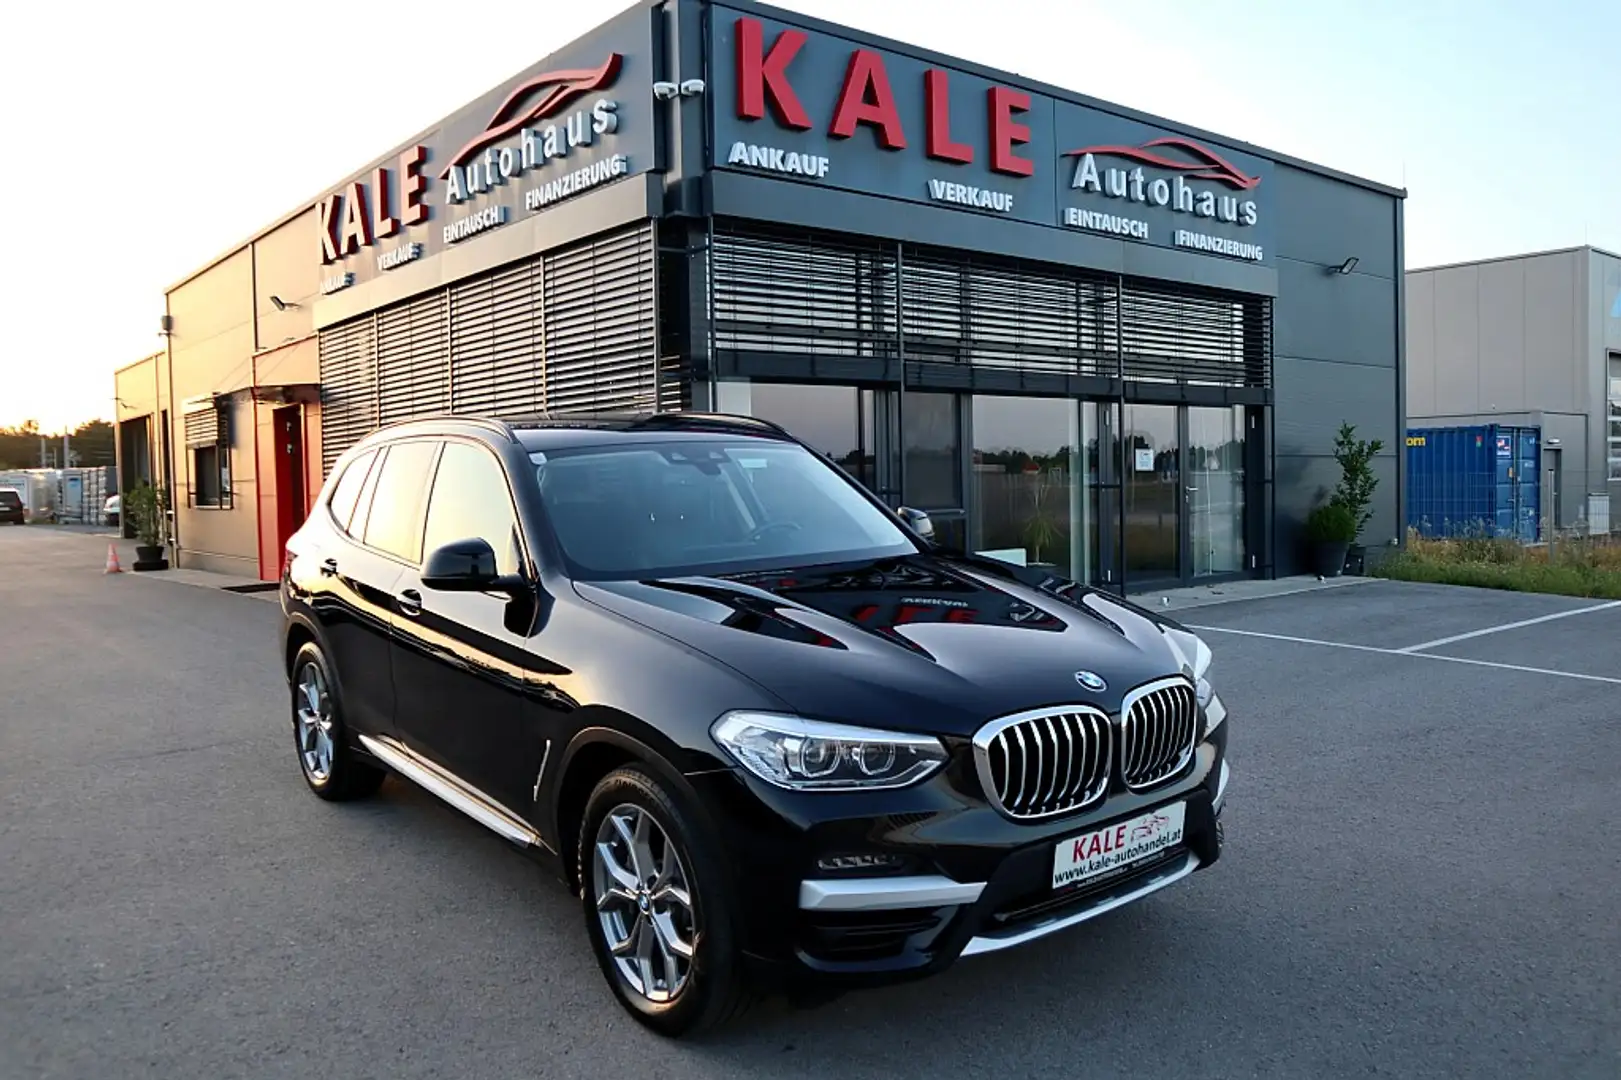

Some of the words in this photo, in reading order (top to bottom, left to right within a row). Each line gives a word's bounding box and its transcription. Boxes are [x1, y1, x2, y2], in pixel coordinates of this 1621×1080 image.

[735, 17, 1034, 177] KALE
[445, 99, 617, 204] Autohaus
[728, 141, 829, 178] ANKAUF
[315, 145, 428, 265] KALE
[525, 154, 627, 210] FINANZIERUNG
[928, 179, 1013, 212] VERKAUF
[1072, 152, 1257, 225] Autohaus
[443, 205, 506, 243] EINTAUSCH
[1064, 208, 1148, 239] EINTAUSCH
[1174, 229, 1263, 260] FINANZIERUNG
[1054, 829, 1181, 883] www.kale-autohandel.at
[1072, 825, 1127, 863] KALE
